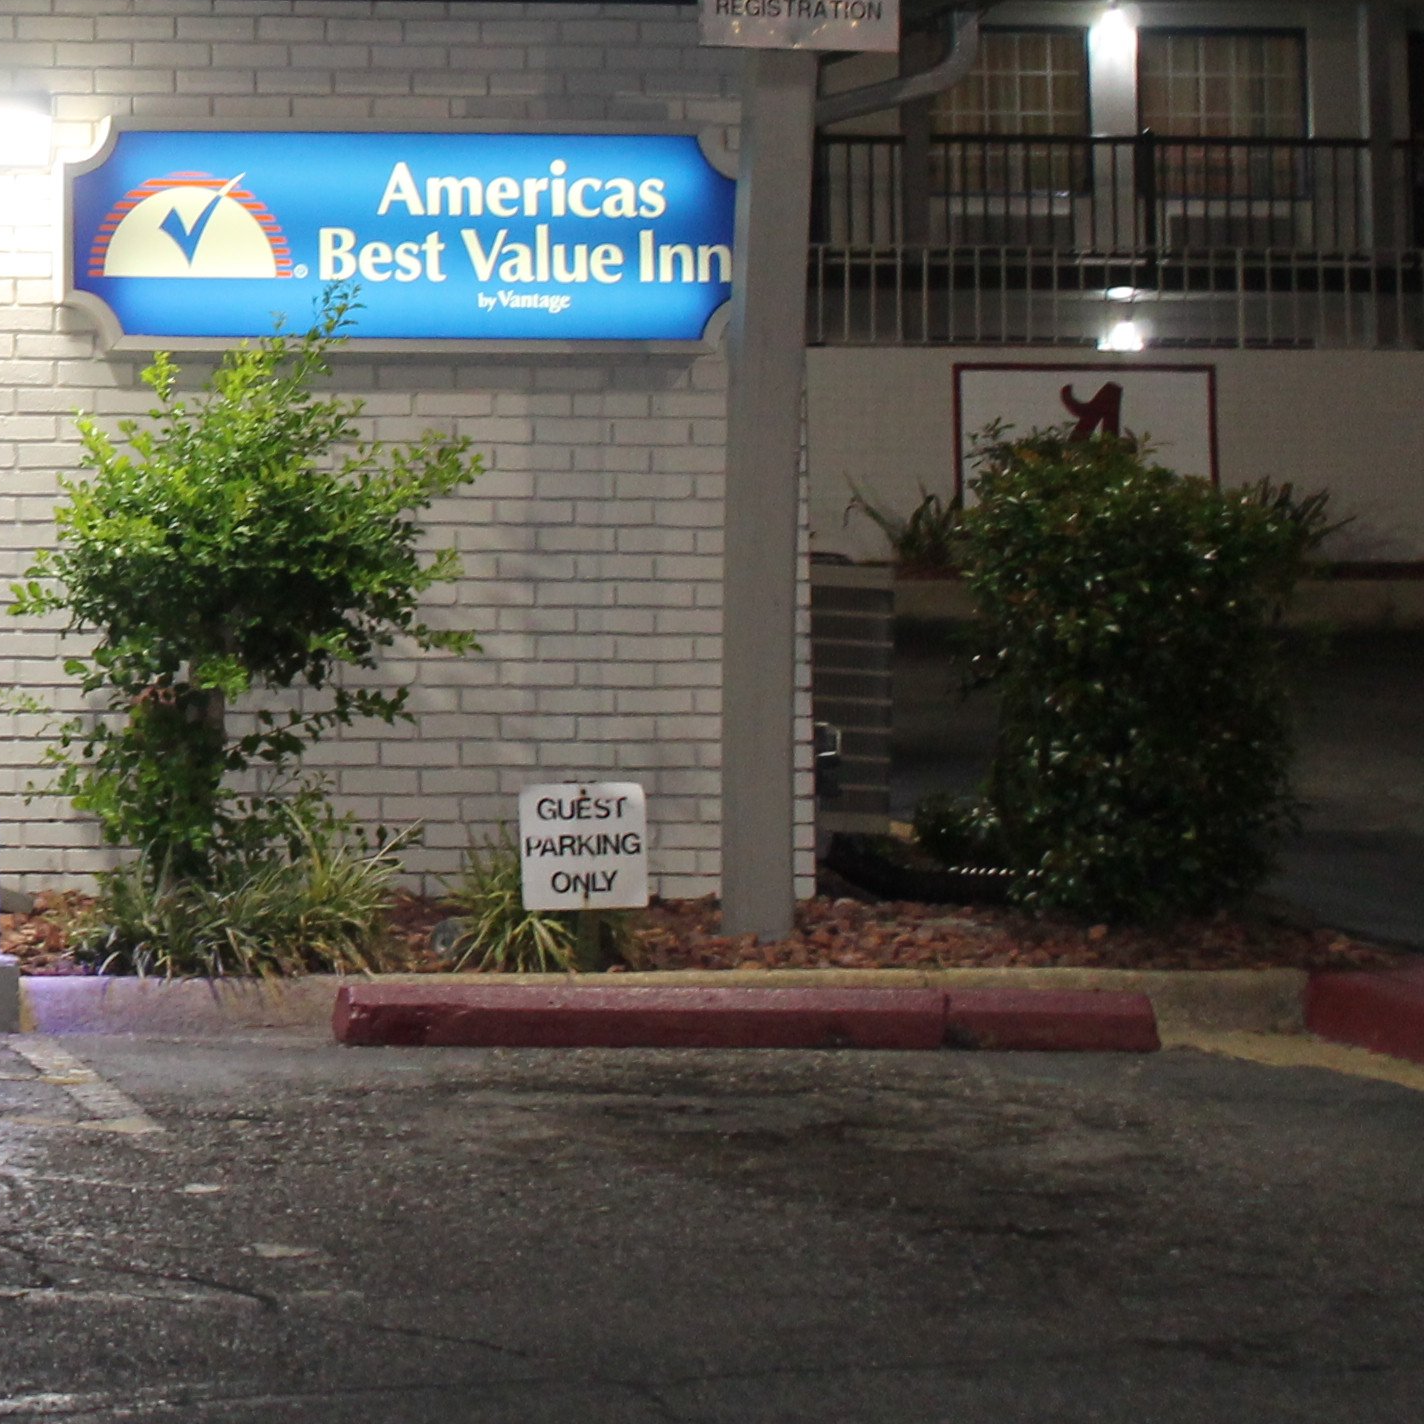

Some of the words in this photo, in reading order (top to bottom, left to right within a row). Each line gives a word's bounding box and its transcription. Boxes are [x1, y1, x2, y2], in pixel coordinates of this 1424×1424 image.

[376, 160, 667, 218] Americas
[319, 227, 446, 283] Best
[461, 225, 624, 284] Value
[638, 230, 733, 284] Inn
[477, 291, 497, 313] by
[497, 289, 572, 314] Vantage
[536, 796, 628, 821] GUEST
[525, 832, 642, 857] PARKING
[551, 869, 618, 894] ONLY
